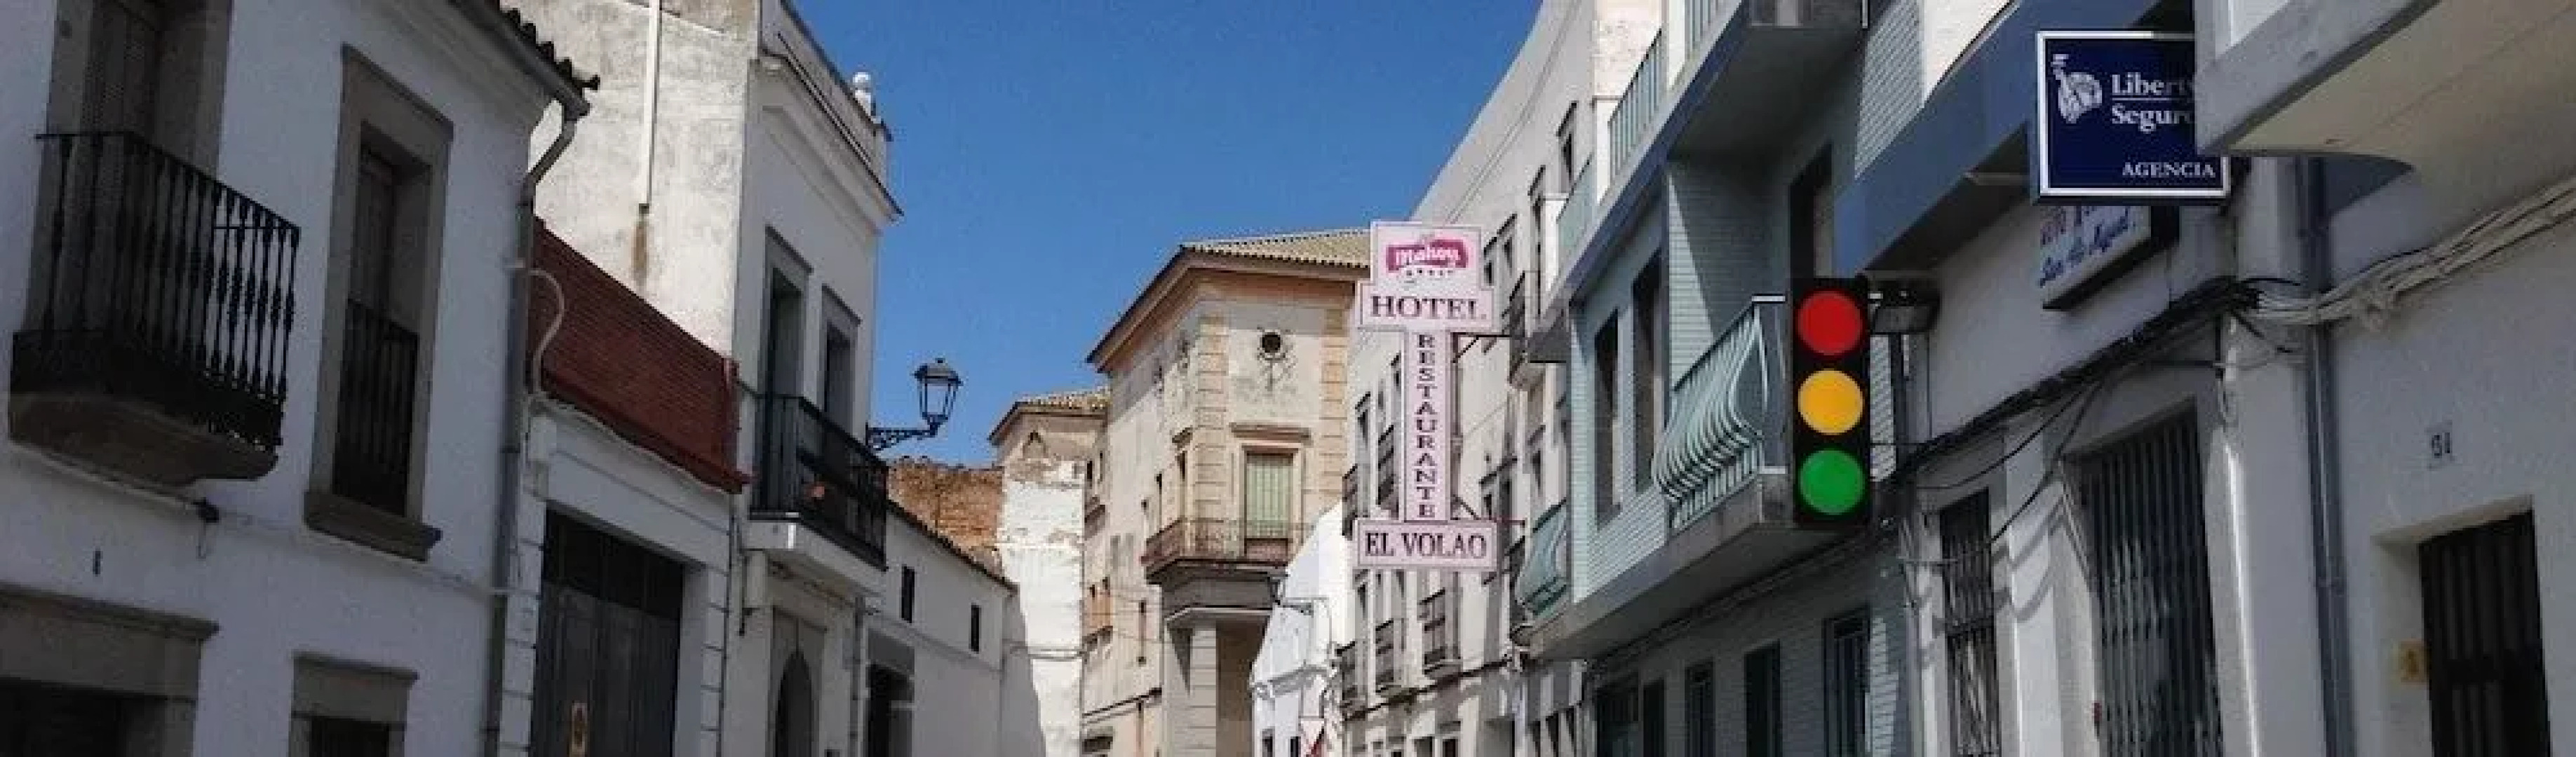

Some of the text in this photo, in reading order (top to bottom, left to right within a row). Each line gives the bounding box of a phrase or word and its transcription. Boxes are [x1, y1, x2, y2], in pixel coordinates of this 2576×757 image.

[2122, 161, 2217, 179] AGENCIA
[1370, 294, 1488, 320] HOTEL
[1415, 333, 1438, 519] RESTAURANTE
[1364, 531, 1488, 559] EL VOLAO
